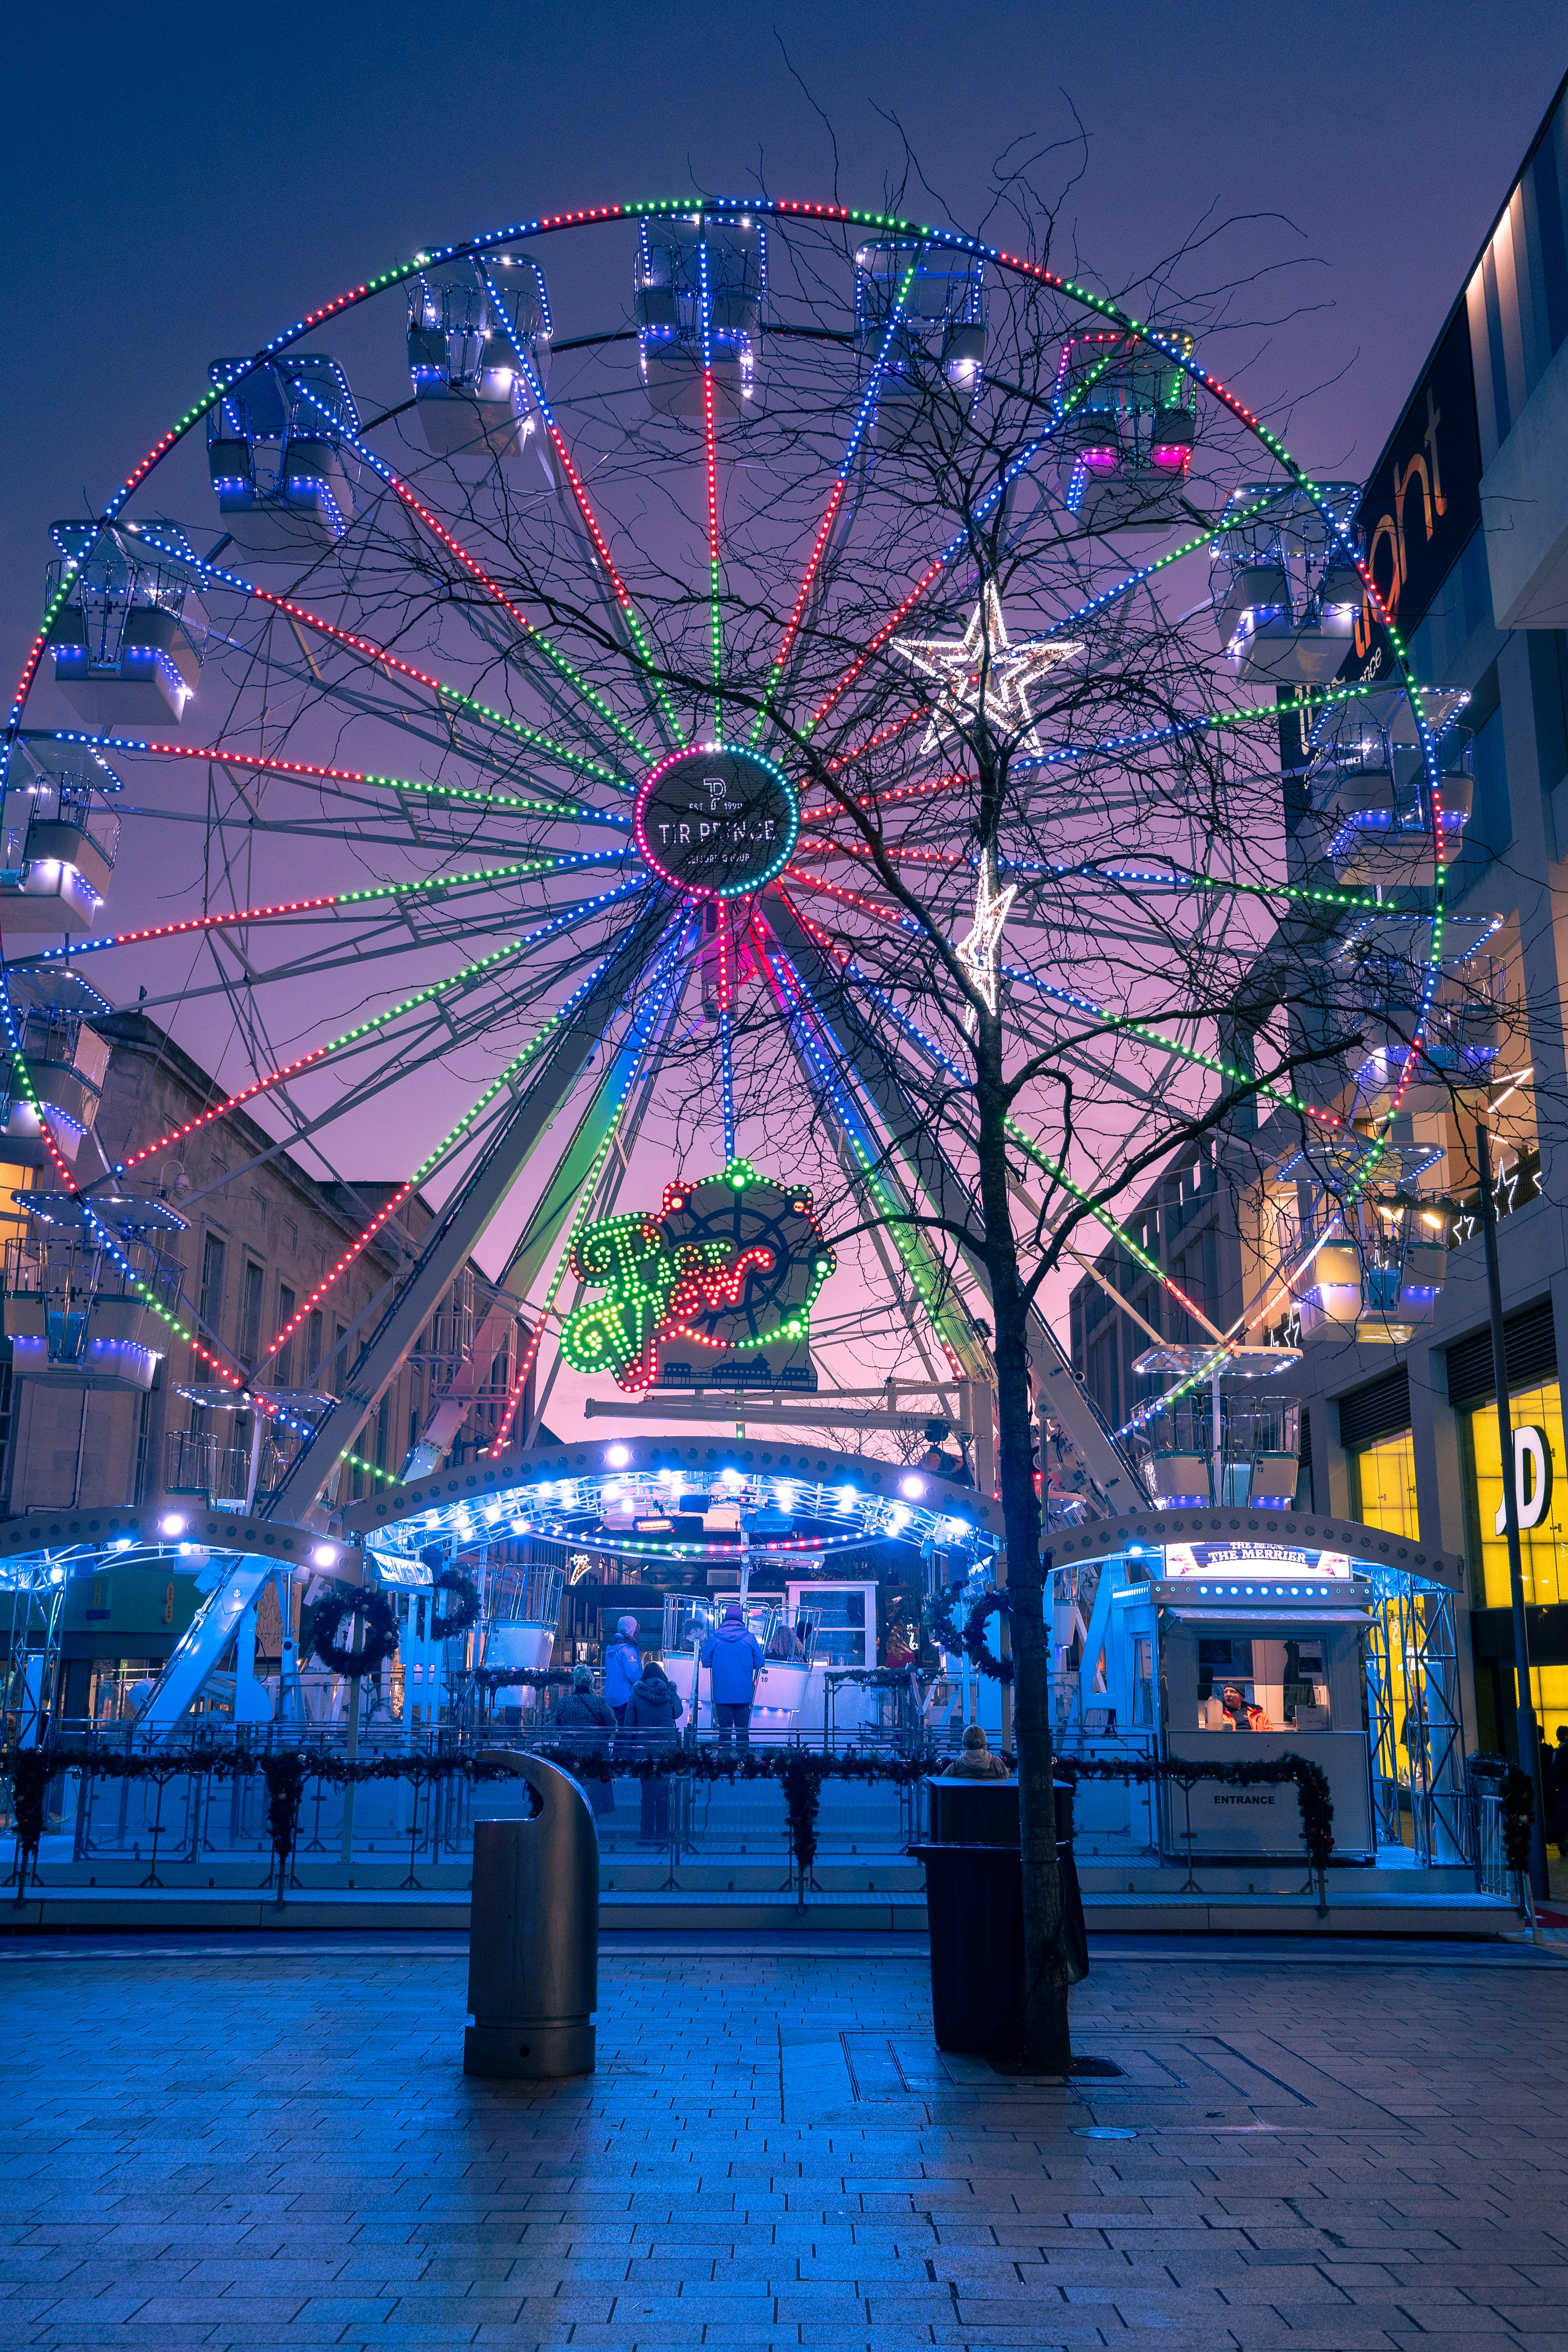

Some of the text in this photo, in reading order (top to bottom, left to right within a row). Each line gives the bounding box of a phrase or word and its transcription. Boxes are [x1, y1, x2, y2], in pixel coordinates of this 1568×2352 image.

[659, 824, 690, 844] TIR
[1230, 1541, 1252, 1550] THE
[1208, 1549, 1306, 1564] THE MERRIER
[1214, 1796, 1275, 1804] ENTRANCE
